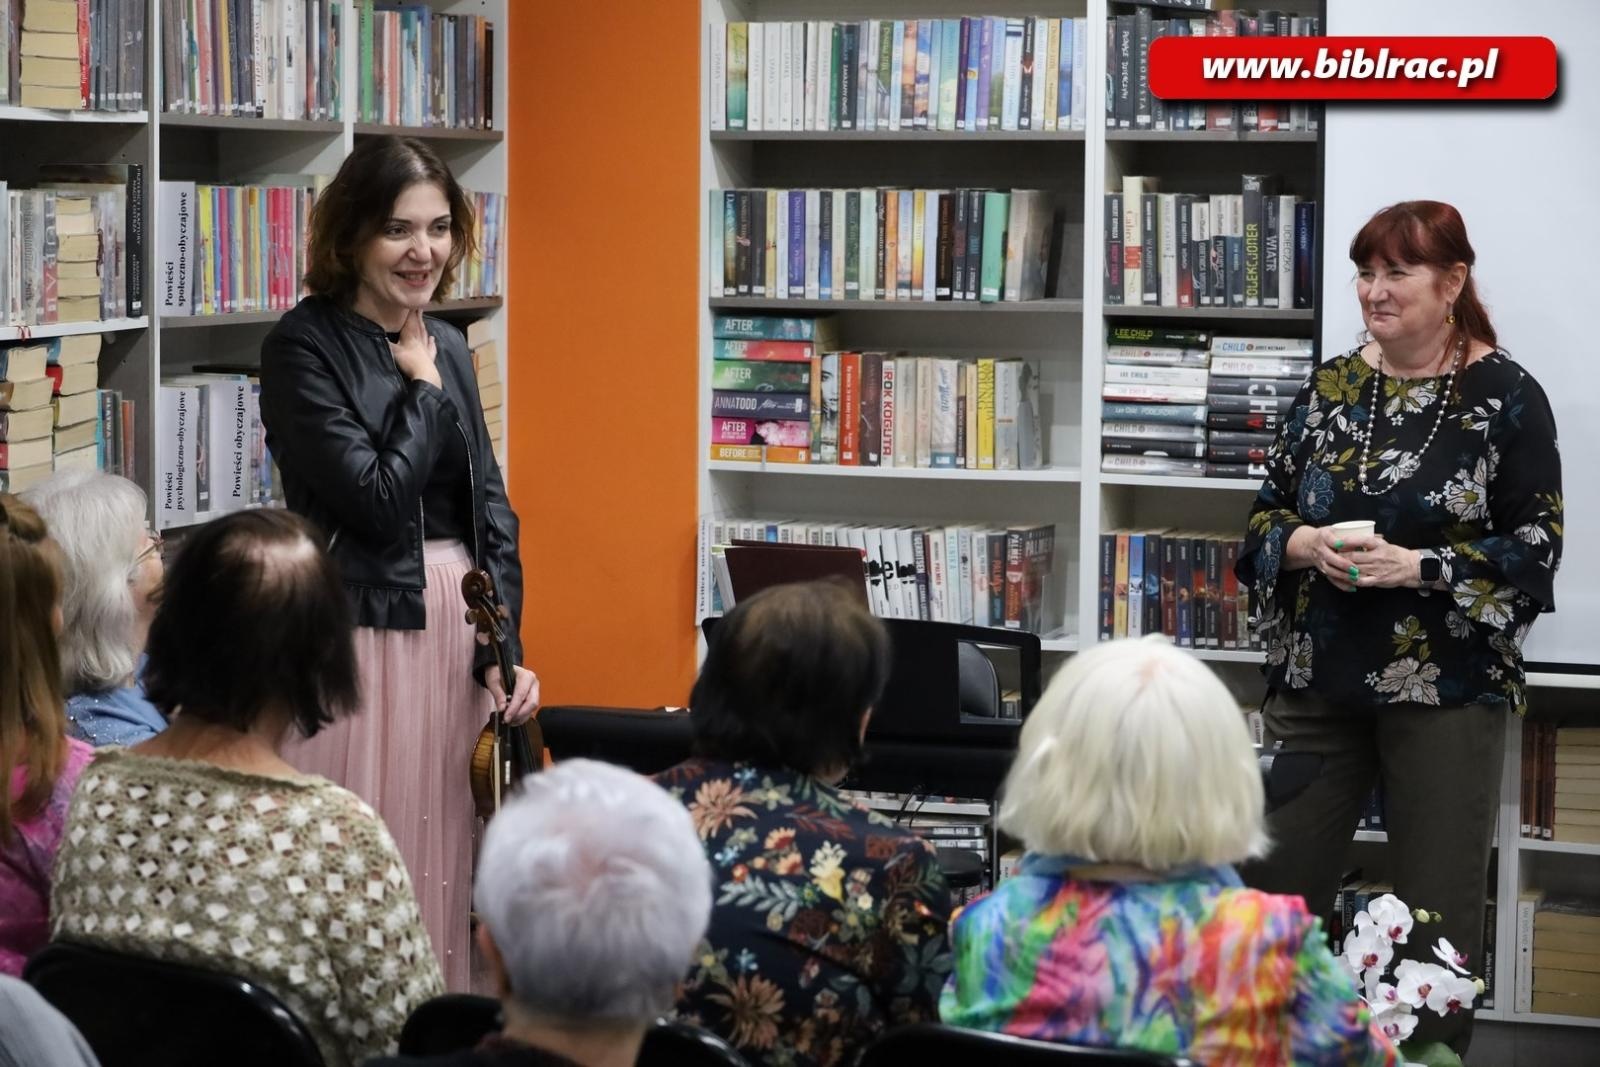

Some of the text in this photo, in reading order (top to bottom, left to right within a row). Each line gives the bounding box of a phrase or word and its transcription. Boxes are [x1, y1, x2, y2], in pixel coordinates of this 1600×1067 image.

[1140, 36, 1148, 110] TERRORYSTA
[177, 191, 189, 308] społeczno-obyczajowe
[1266, 234, 1277, 273] WIATR
[1282, 224, 1293, 274] UCIECZKA
[164, 261, 174, 307] Powieści
[725, 318, 753, 331] AFTER
[1114, 329, 1154, 338] LEE CHILD
[724, 341, 748, 352] AFTER
[1222, 342, 1246, 352] CHILD
[724, 367, 752, 379] AFTER
[721, 422, 747, 433] AFTER
[883, 370, 894, 457] ROK KOGUTA
[175, 391, 188, 511] psychologiczno-obyczajowe
[232, 385, 246, 498] Powieści obyczajowe
[720, 448, 748, 459] BEFORE
[164, 472, 173, 510] Powieści
[914, 536, 926, 574] GERRITSEN
[1010, 534, 1020, 566] PALMER
